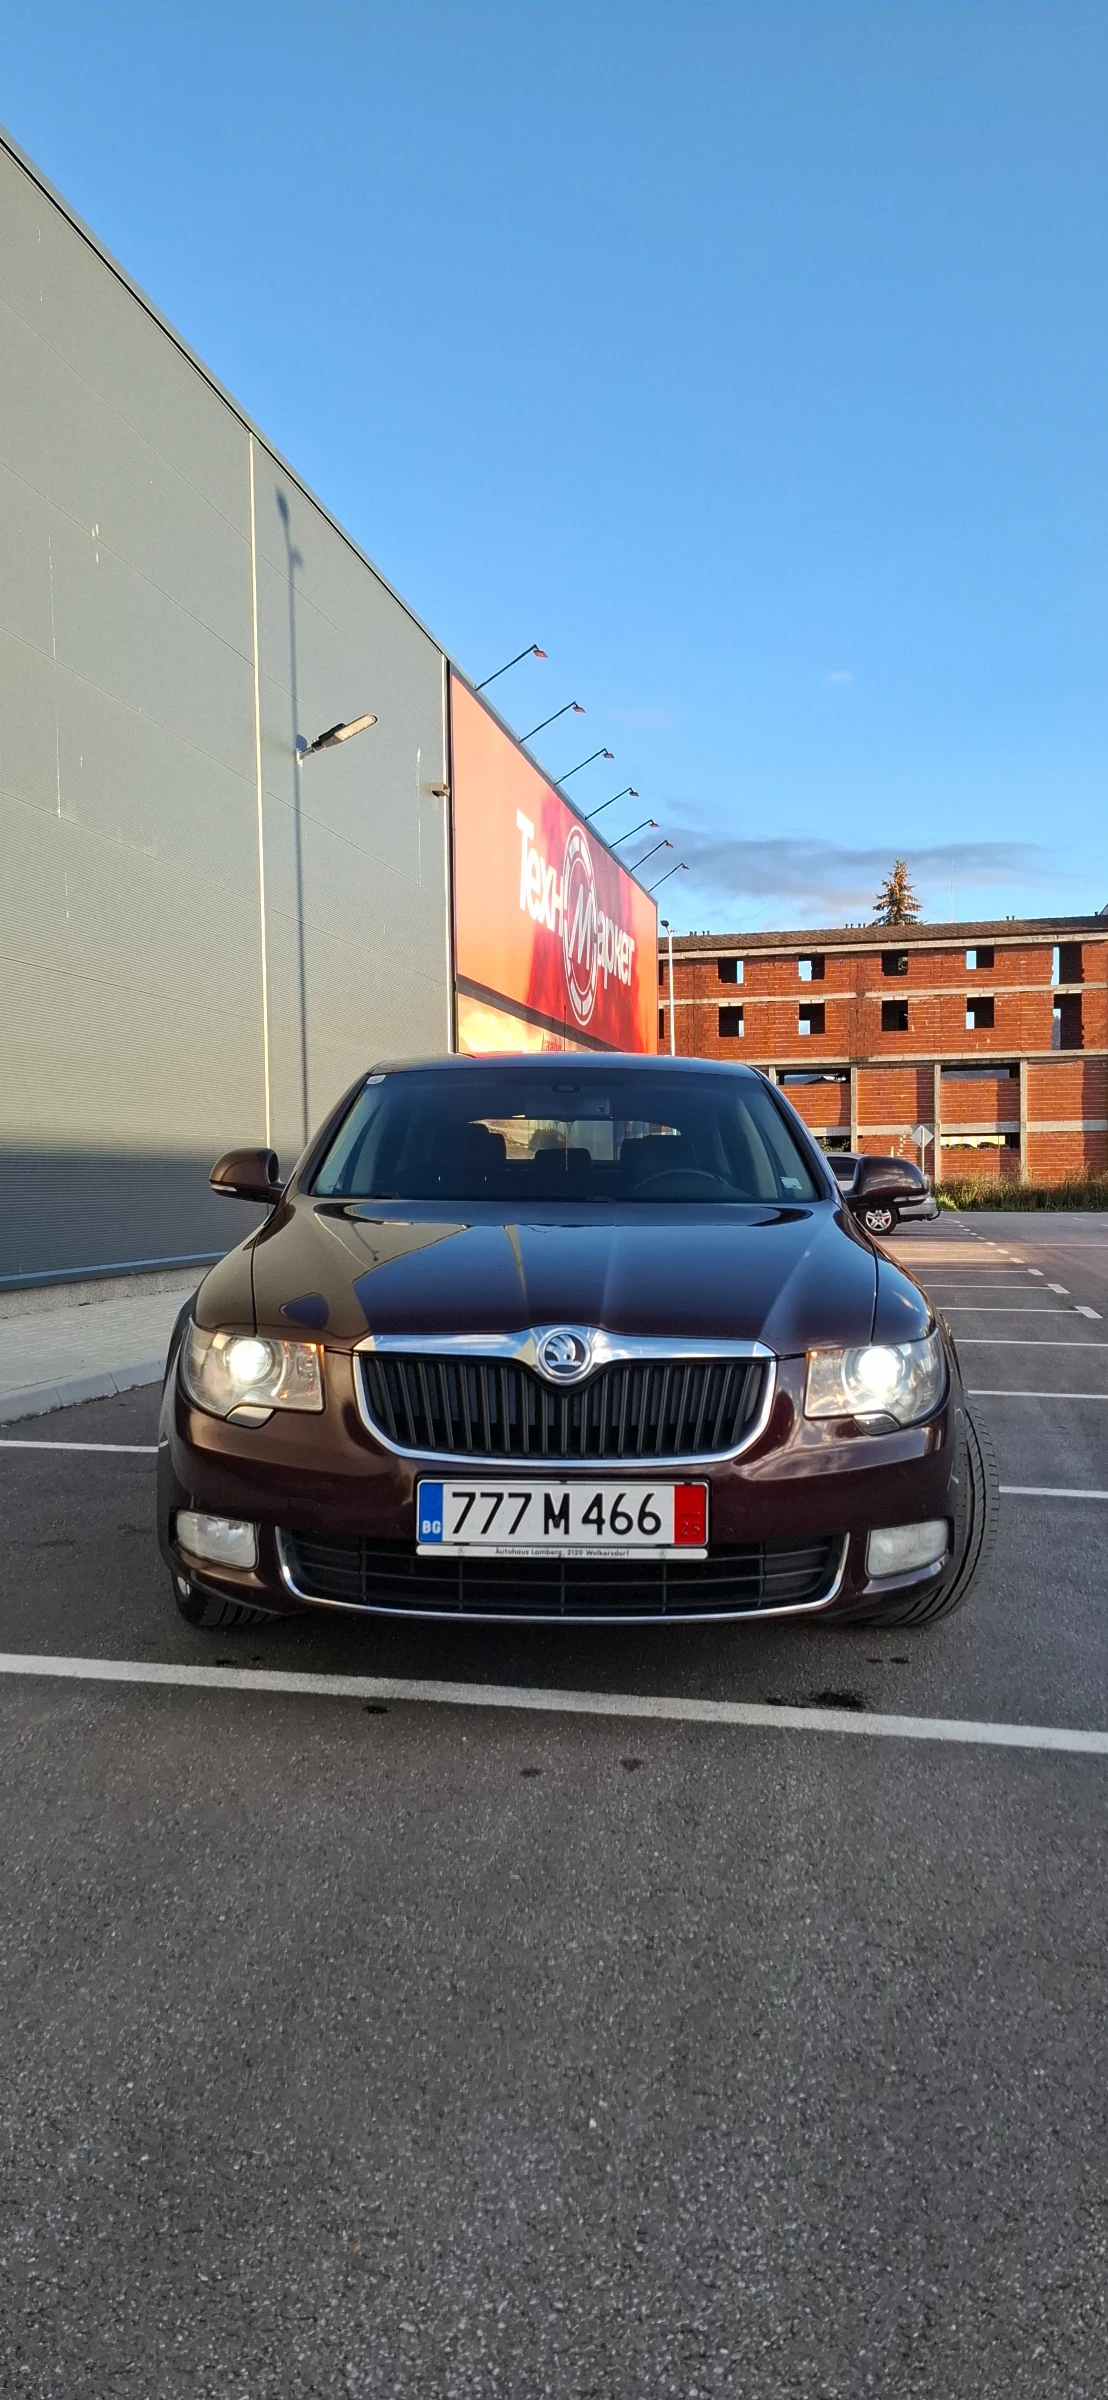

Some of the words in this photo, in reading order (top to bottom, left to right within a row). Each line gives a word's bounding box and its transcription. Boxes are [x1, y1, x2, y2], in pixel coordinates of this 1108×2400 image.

[452, 1491, 533, 1535] 777
[543, 1492, 570, 1535] M
[581, 1492, 662, 1535] 466
[422, 1520, 441, 1534] BG
[495, 1547, 529, 1555] Autohaus
